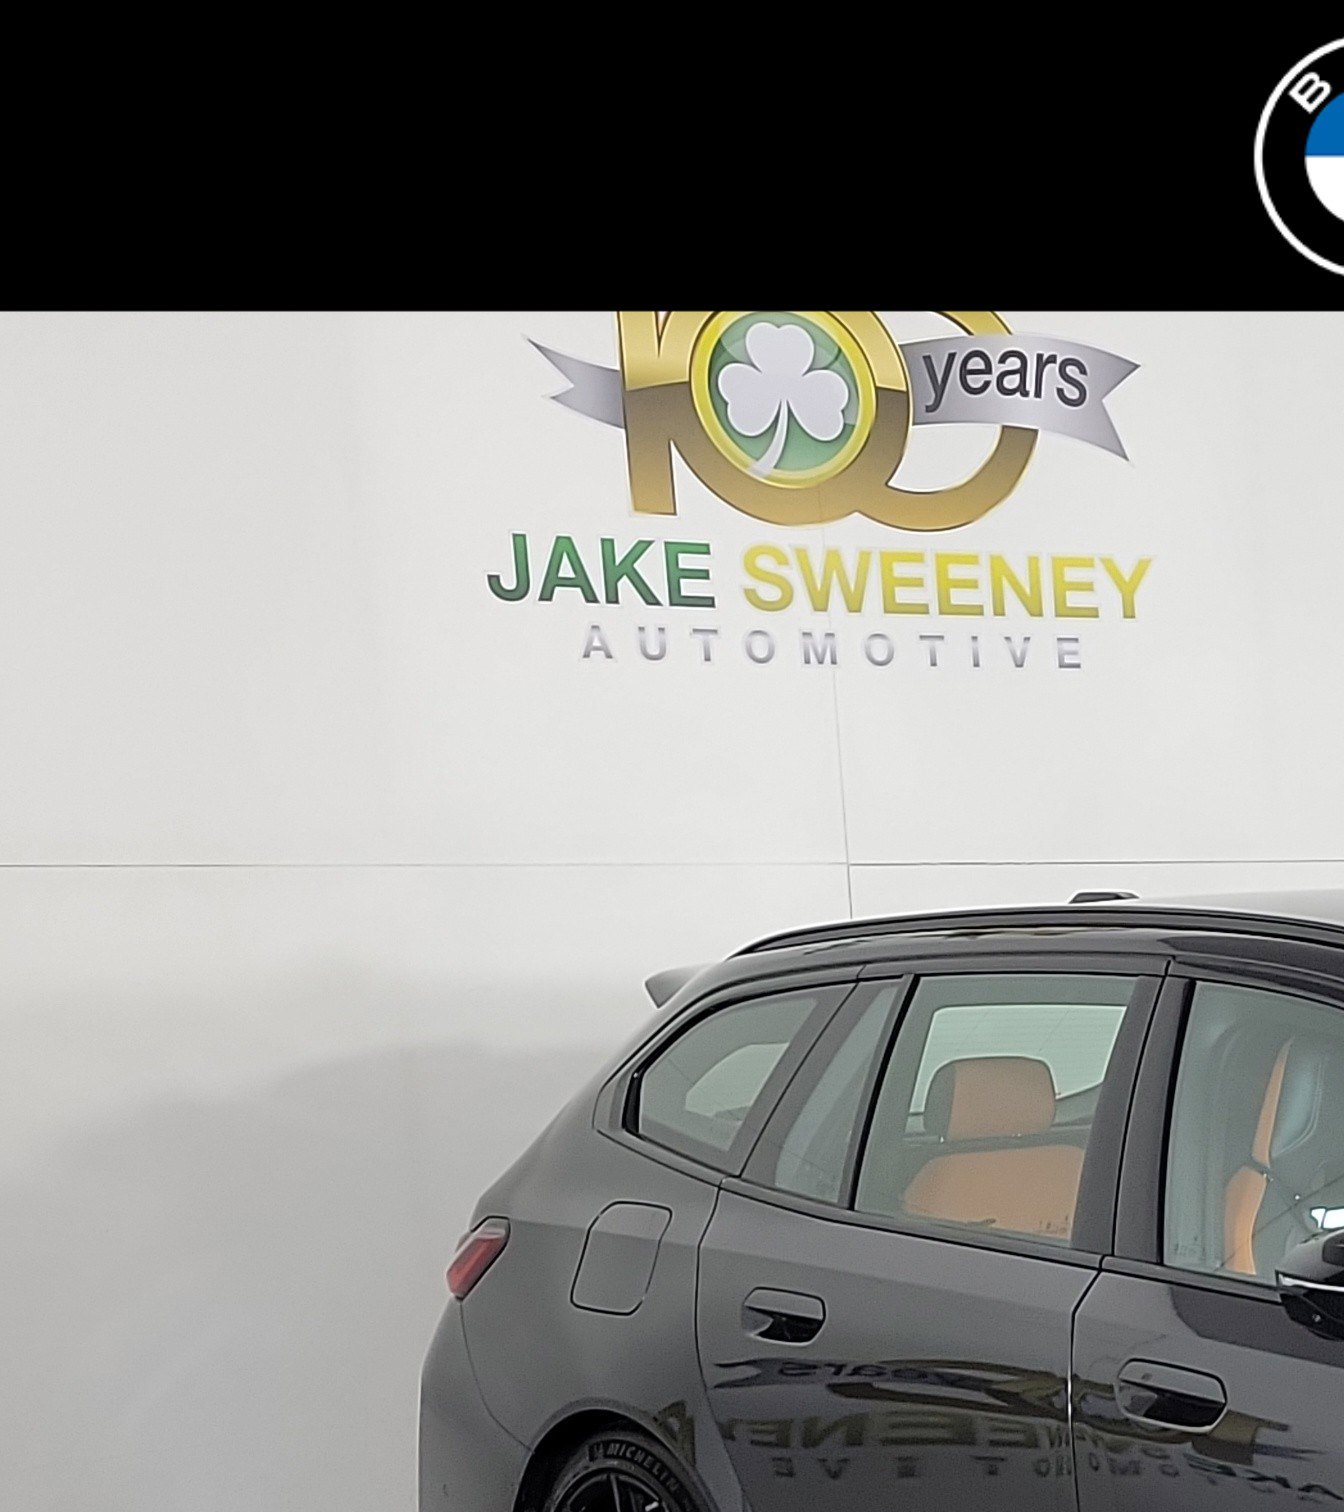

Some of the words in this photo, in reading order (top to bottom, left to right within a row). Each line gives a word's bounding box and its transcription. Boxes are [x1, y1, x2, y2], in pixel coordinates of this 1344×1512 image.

[922, 346, 1088, 413] years
[486, 533, 716, 609] JAKE
[742, 545, 1152, 619] SWEENEY
[582, 625, 1082, 669] AUTOMOTIVE
